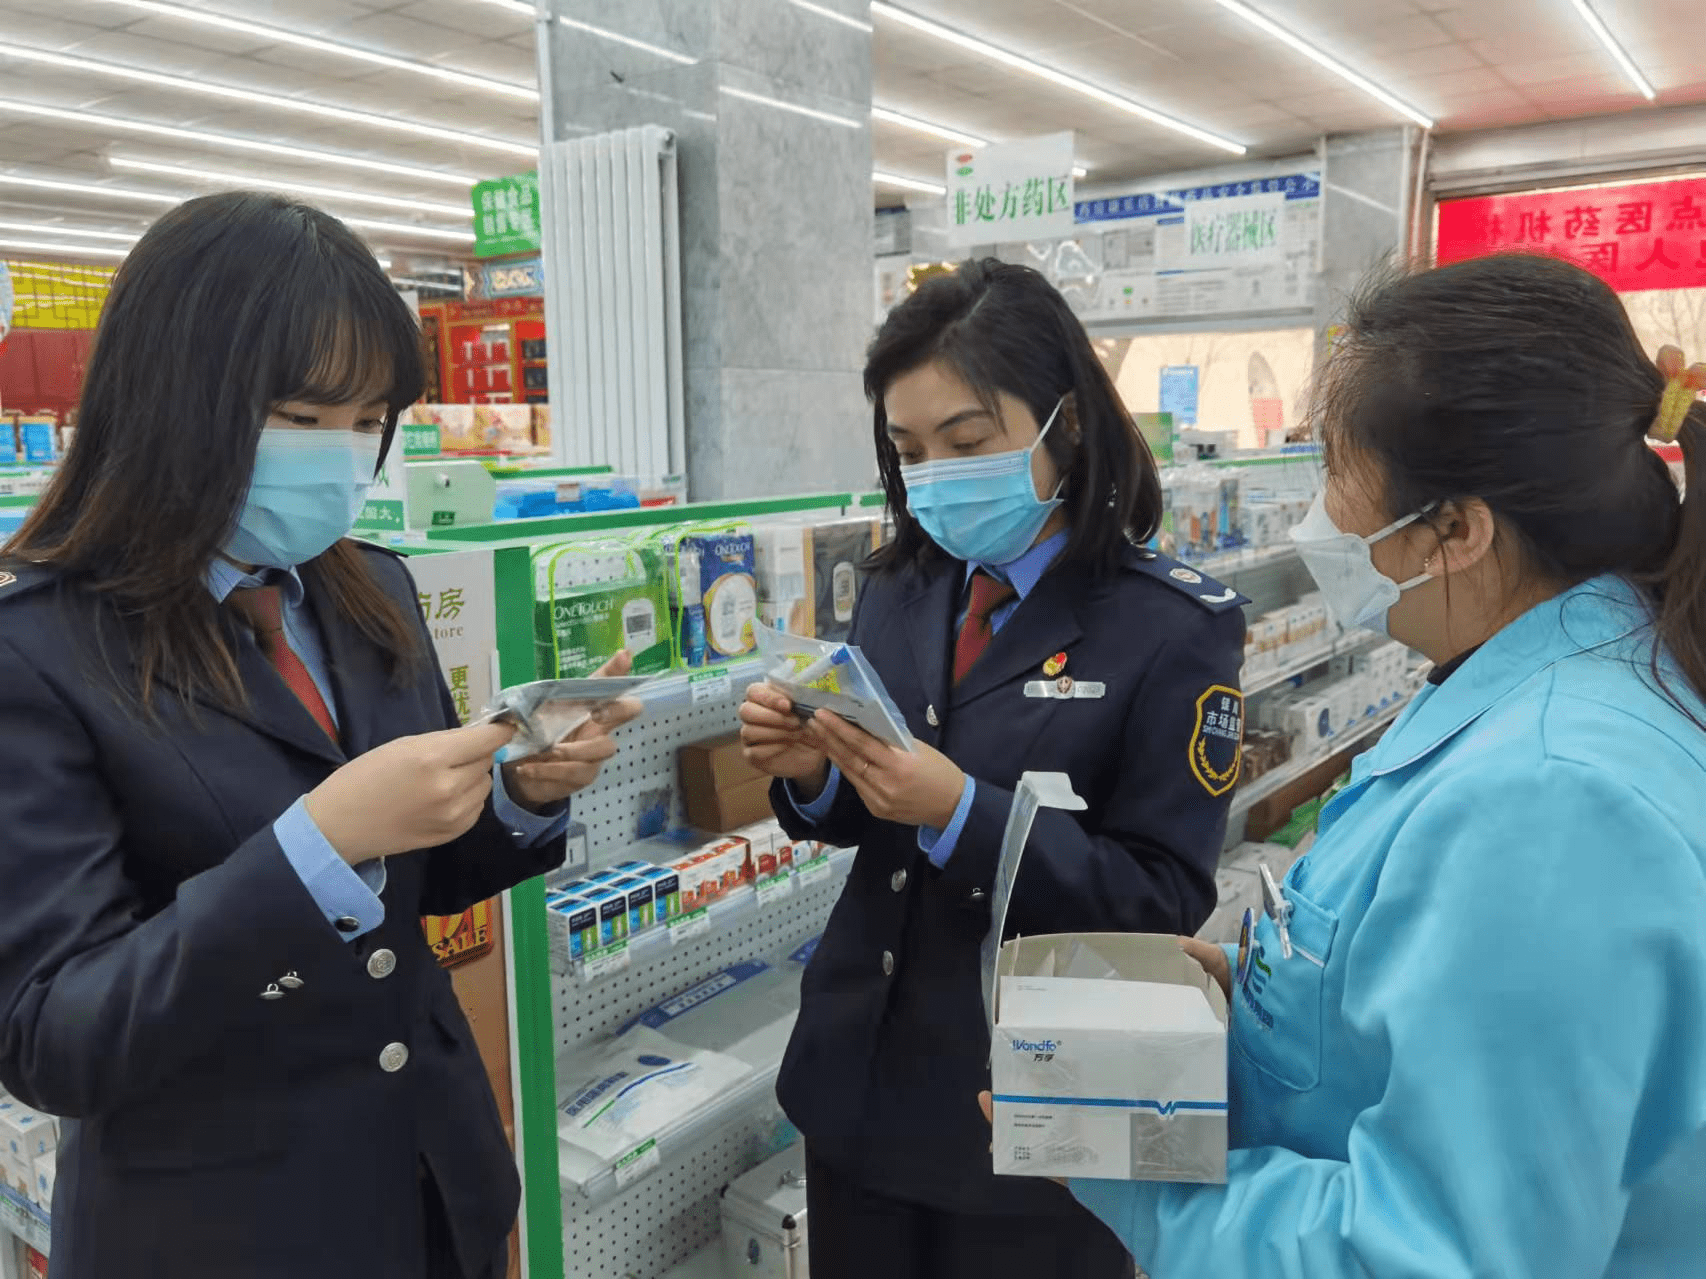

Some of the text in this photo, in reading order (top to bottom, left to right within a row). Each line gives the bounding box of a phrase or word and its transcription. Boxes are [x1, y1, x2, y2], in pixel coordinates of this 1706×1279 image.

[954, 173, 1070, 225] 非处方药区
[1190, 207, 1278, 254] 医疗器械区
[433, 625, 464, 641] tore
[431, 926, 490, 961] SALE
[1012, 1039, 1057, 1051] Wondfo
